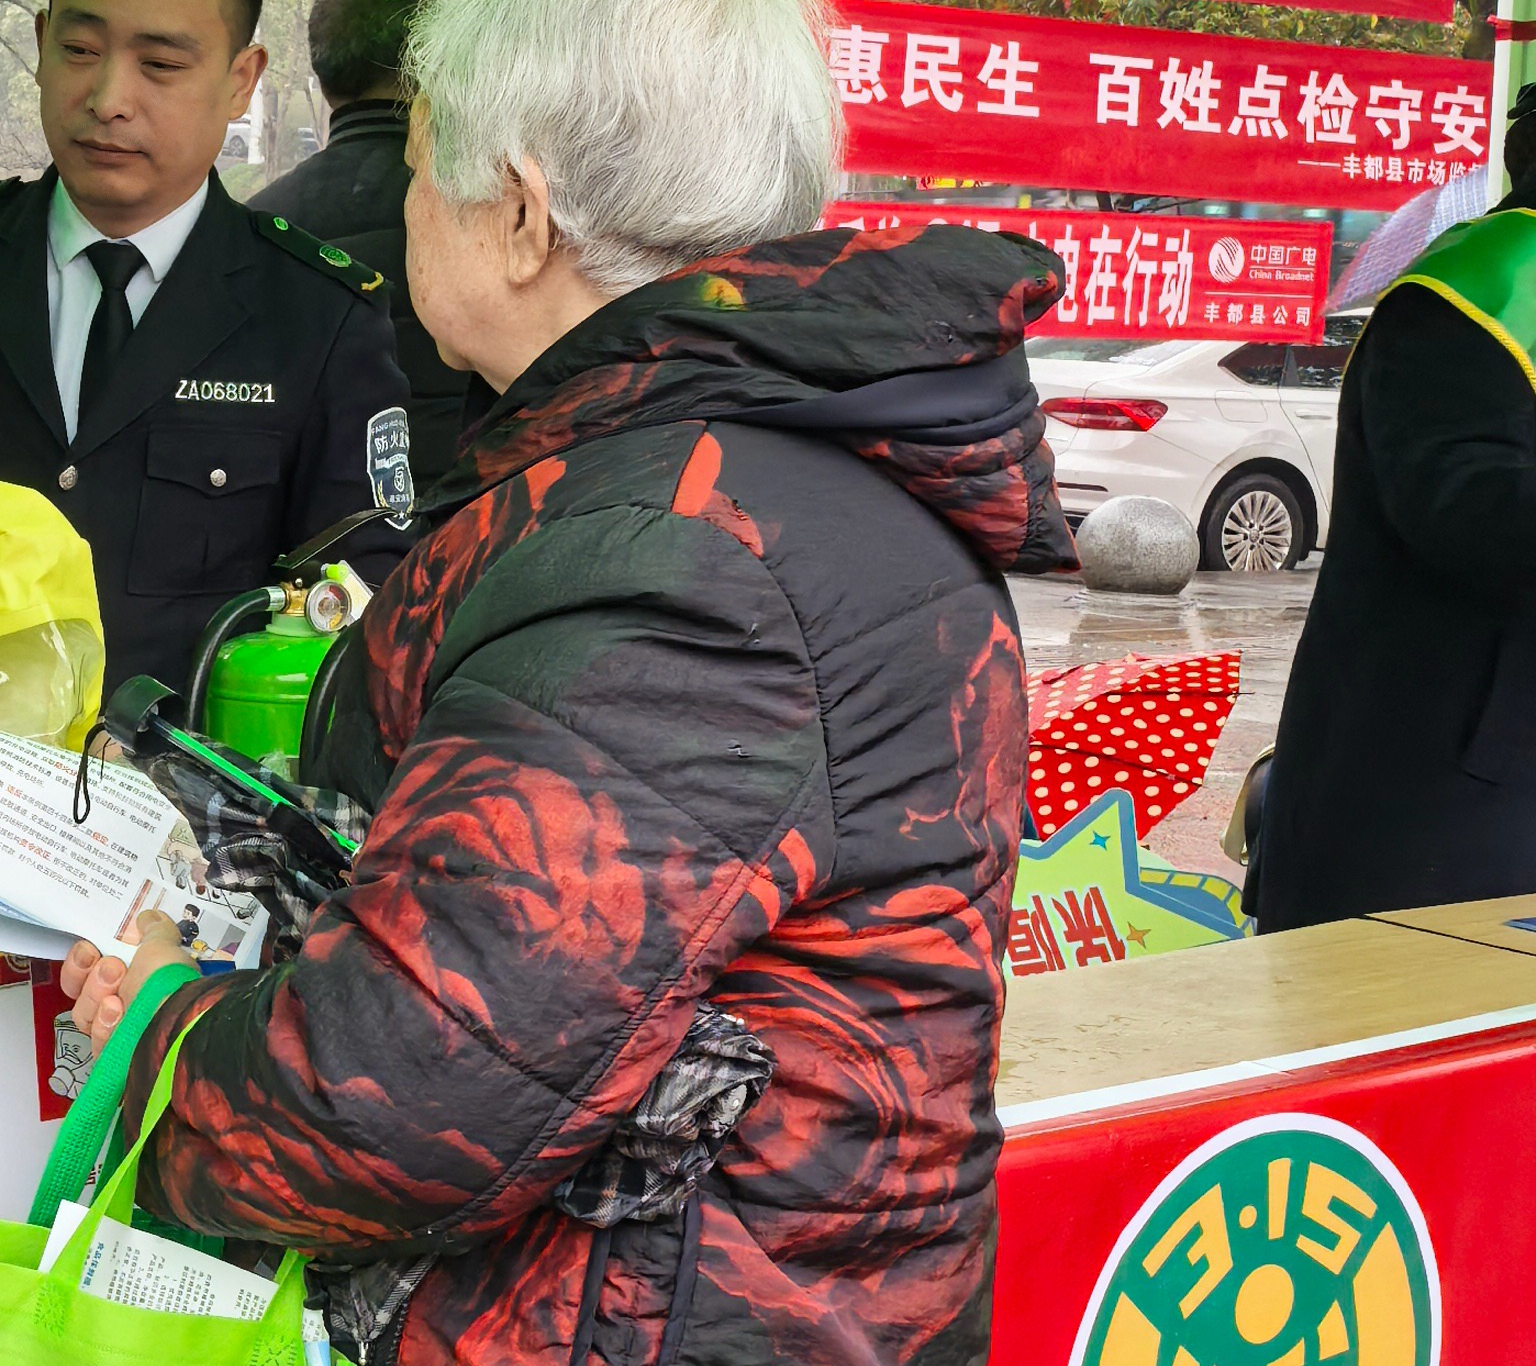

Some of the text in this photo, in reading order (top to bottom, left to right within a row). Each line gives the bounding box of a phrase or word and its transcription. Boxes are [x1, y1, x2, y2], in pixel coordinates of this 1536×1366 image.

[830, 24, 1487, 157] 惠民生 百姓点检守安
[1251, 244, 1316, 266] 中国广电
[1029, 222, 1194, 327] 电在行动
[1249, 269, 1272, 281] China
[1204, 303, 1311, 327] 丰都县公司
[175, 379, 276, 404] ZA068021
